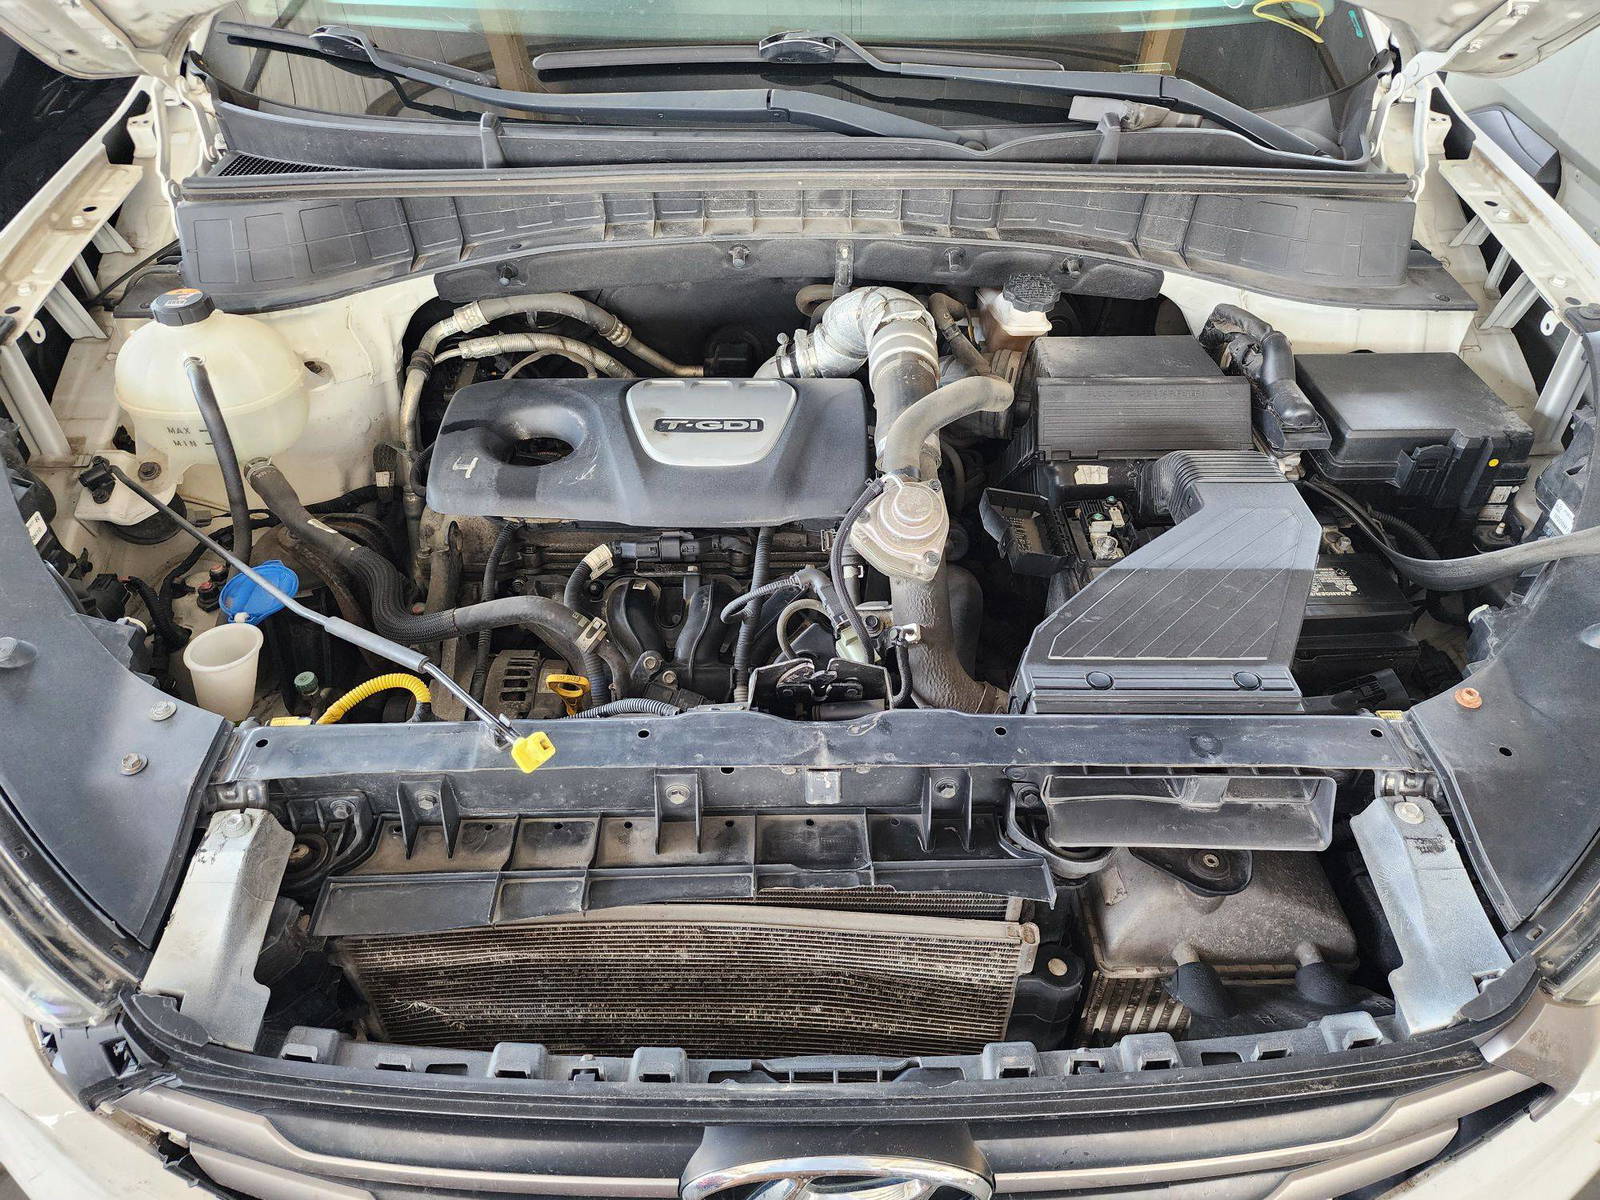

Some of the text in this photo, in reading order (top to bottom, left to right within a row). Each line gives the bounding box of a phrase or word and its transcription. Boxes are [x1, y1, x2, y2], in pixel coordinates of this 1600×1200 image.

[662, 420, 758, 430] T-GDI
[166, 426, 191, 434] MAX
[172, 439, 198, 447] MIN
